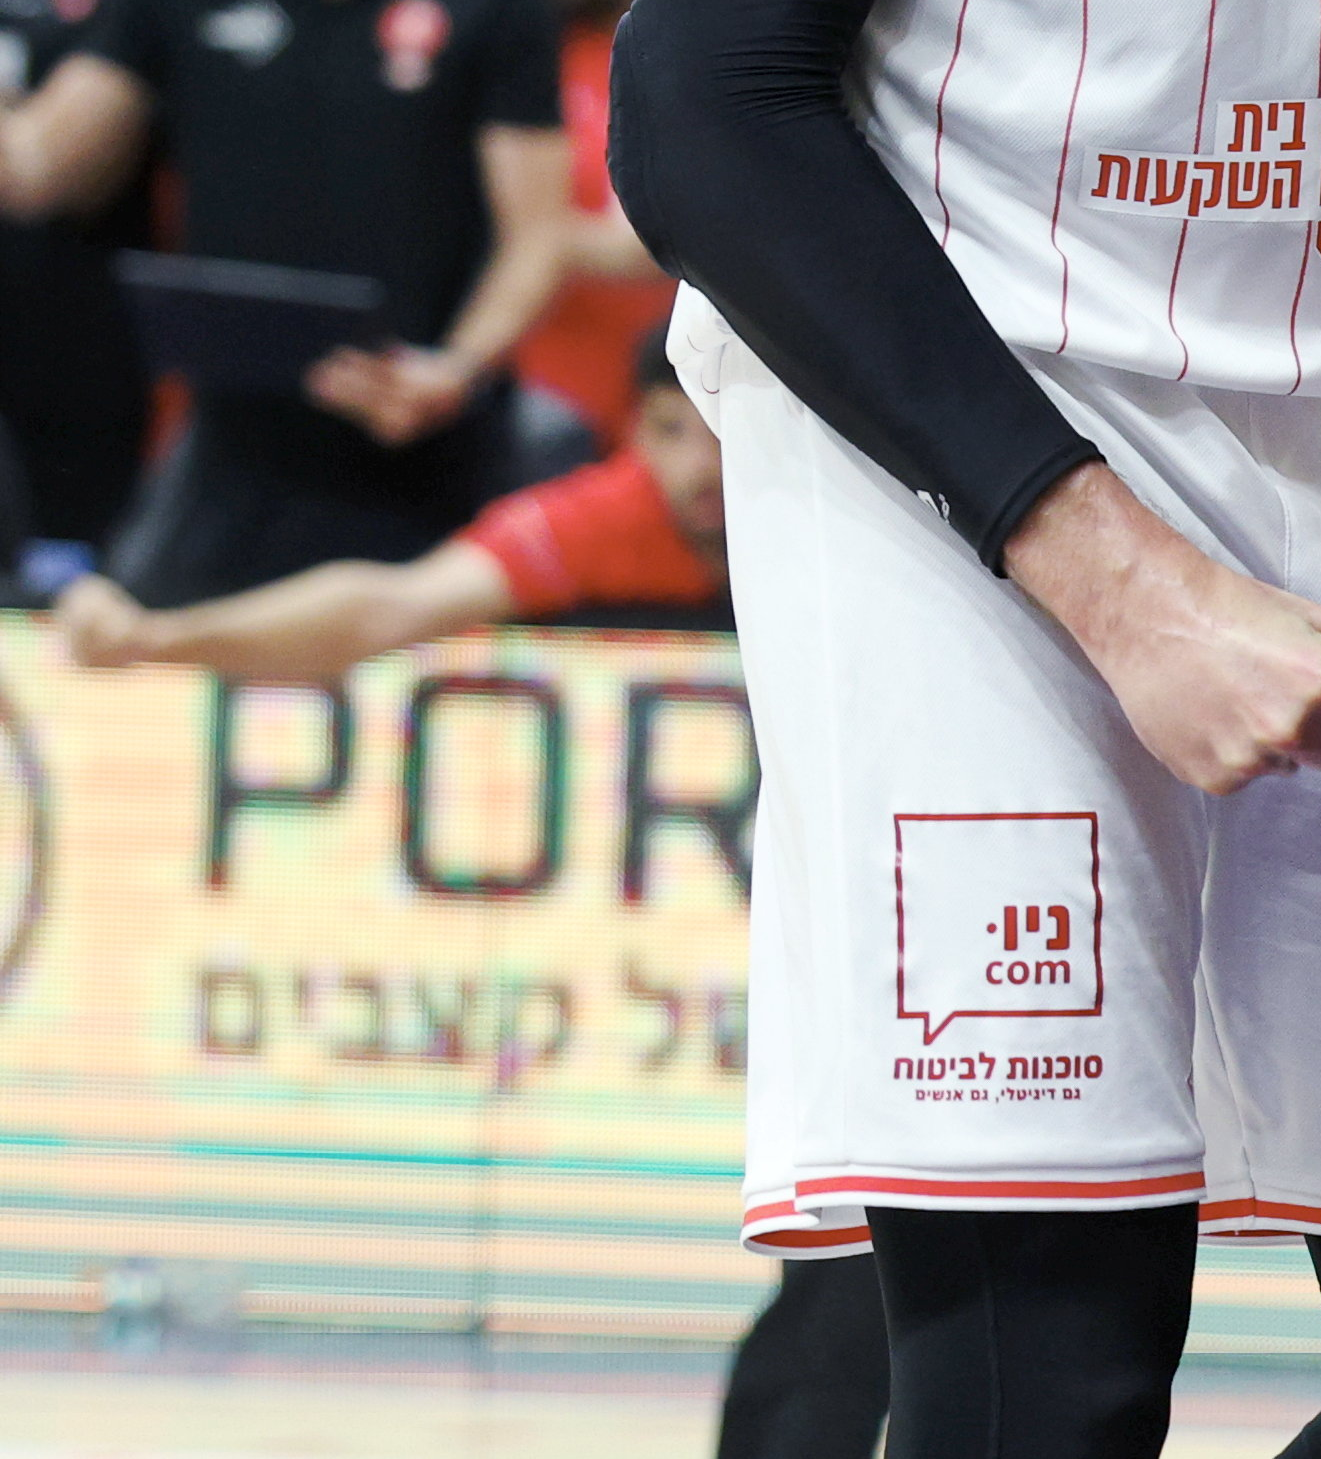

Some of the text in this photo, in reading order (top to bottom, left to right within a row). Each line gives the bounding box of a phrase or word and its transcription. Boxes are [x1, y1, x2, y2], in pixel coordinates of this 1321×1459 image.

[1227, 101, 1306, 153] בית
[1090, 152, 1303, 218] השקעות
[985, 959, 1071, 985] com
[893, 1051, 1104, 1081] סוכנות לביטוח
[915, 1089, 963, 1101] אנשים
[970, 1089, 989, 1101] גם
[1062, 1087, 1081, 1101] גם
